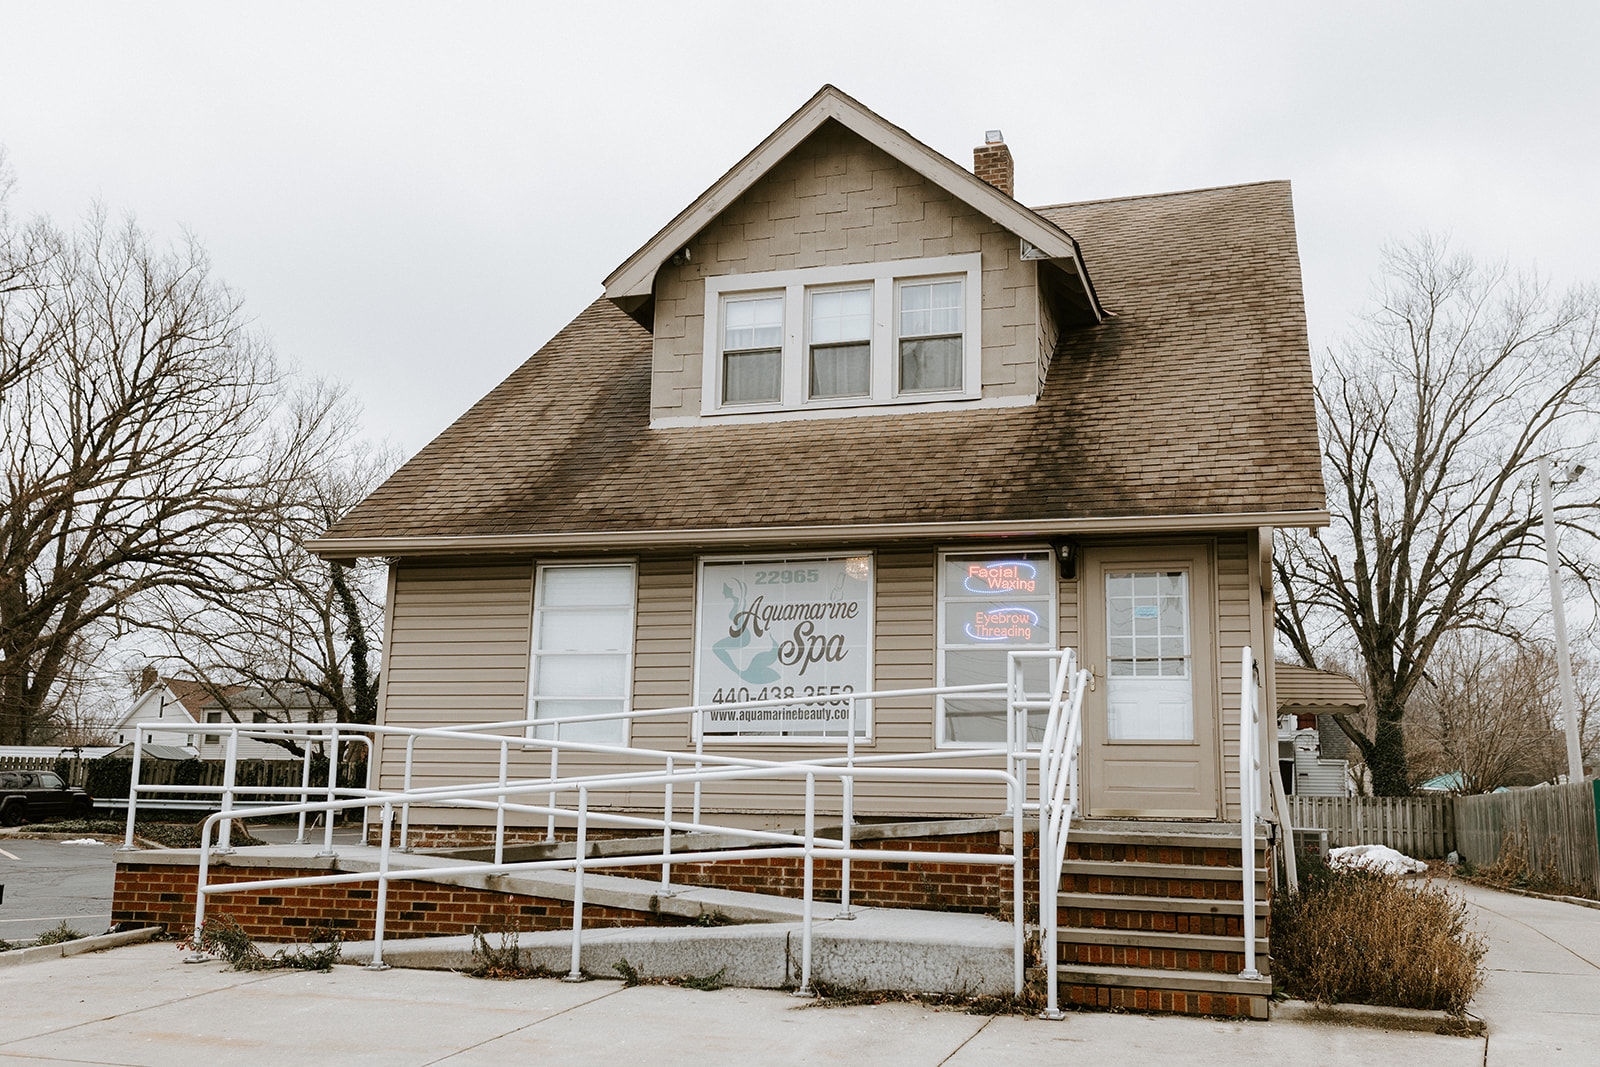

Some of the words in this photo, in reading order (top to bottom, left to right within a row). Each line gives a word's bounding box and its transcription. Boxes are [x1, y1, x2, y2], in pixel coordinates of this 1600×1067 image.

[754, 569, 819, 584] 22965
[968, 566, 1018, 578] Facial
[987, 578, 1036, 592] Waxing
[729, 596, 859, 638] Aquamarine
[976, 612, 1030, 626] Eyebrow
[975, 625, 1031, 640] Threading
[778, 620, 848, 676] Spa
[712, 685, 854, 706] 440-4383553
